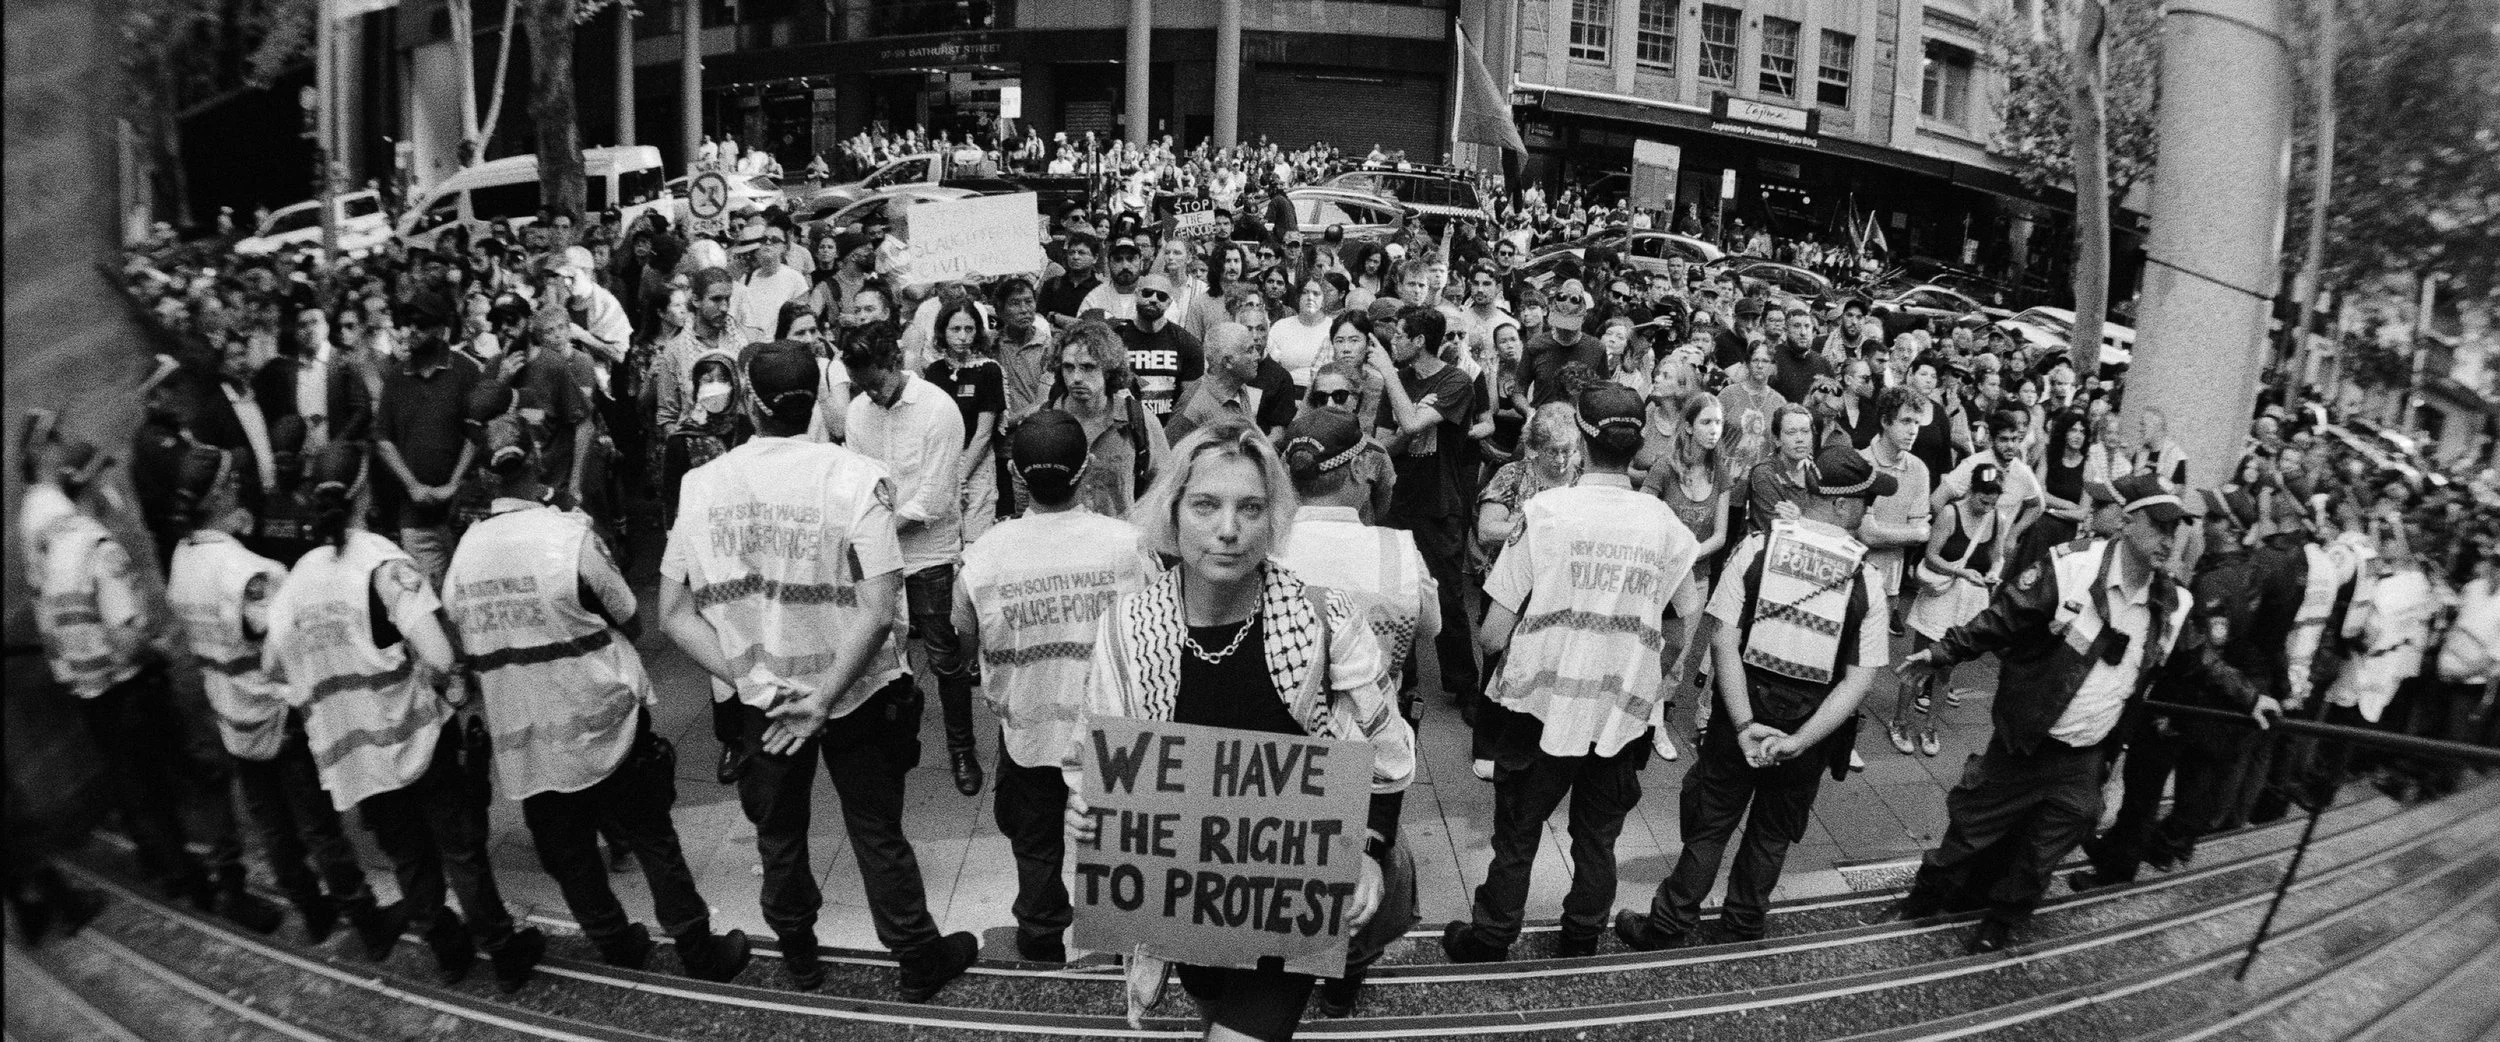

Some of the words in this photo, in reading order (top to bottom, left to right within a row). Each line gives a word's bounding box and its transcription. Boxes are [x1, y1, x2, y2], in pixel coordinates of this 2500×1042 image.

[909, 45, 960, 57] BATHURST
[964, 43, 1001, 53] STREET
[1711, 121, 1745, 134] Japanese
[1746, 126, 1778, 139] Premium
[1173, 198, 1210, 216] STOP
[1184, 213, 1203, 226] THE
[1127, 349, 1178, 371] FREE
[708, 505, 734, 522] NEW
[776, 503, 820, 523] WALES
[763, 524, 821, 562] FORCE
[1570, 540, 1595, 557] NEW
[1570, 560, 1622, 593] POLICE
[1777, 549, 1848, 584] POLICE
[1024, 574, 1070, 595] SOUTH
[1070, 570, 1115, 588] WALES
[1001, 597, 1061, 631] POLICE
[1092, 729, 1186, 794] WE
[1212, 740, 1329, 797] HAVE
[1086, 806, 1181, 858] THE
[1200, 815, 1342, 866] RIGHT
[1076, 863, 1144, 911] TO
[1163, 867, 1356, 937] PROTEST
